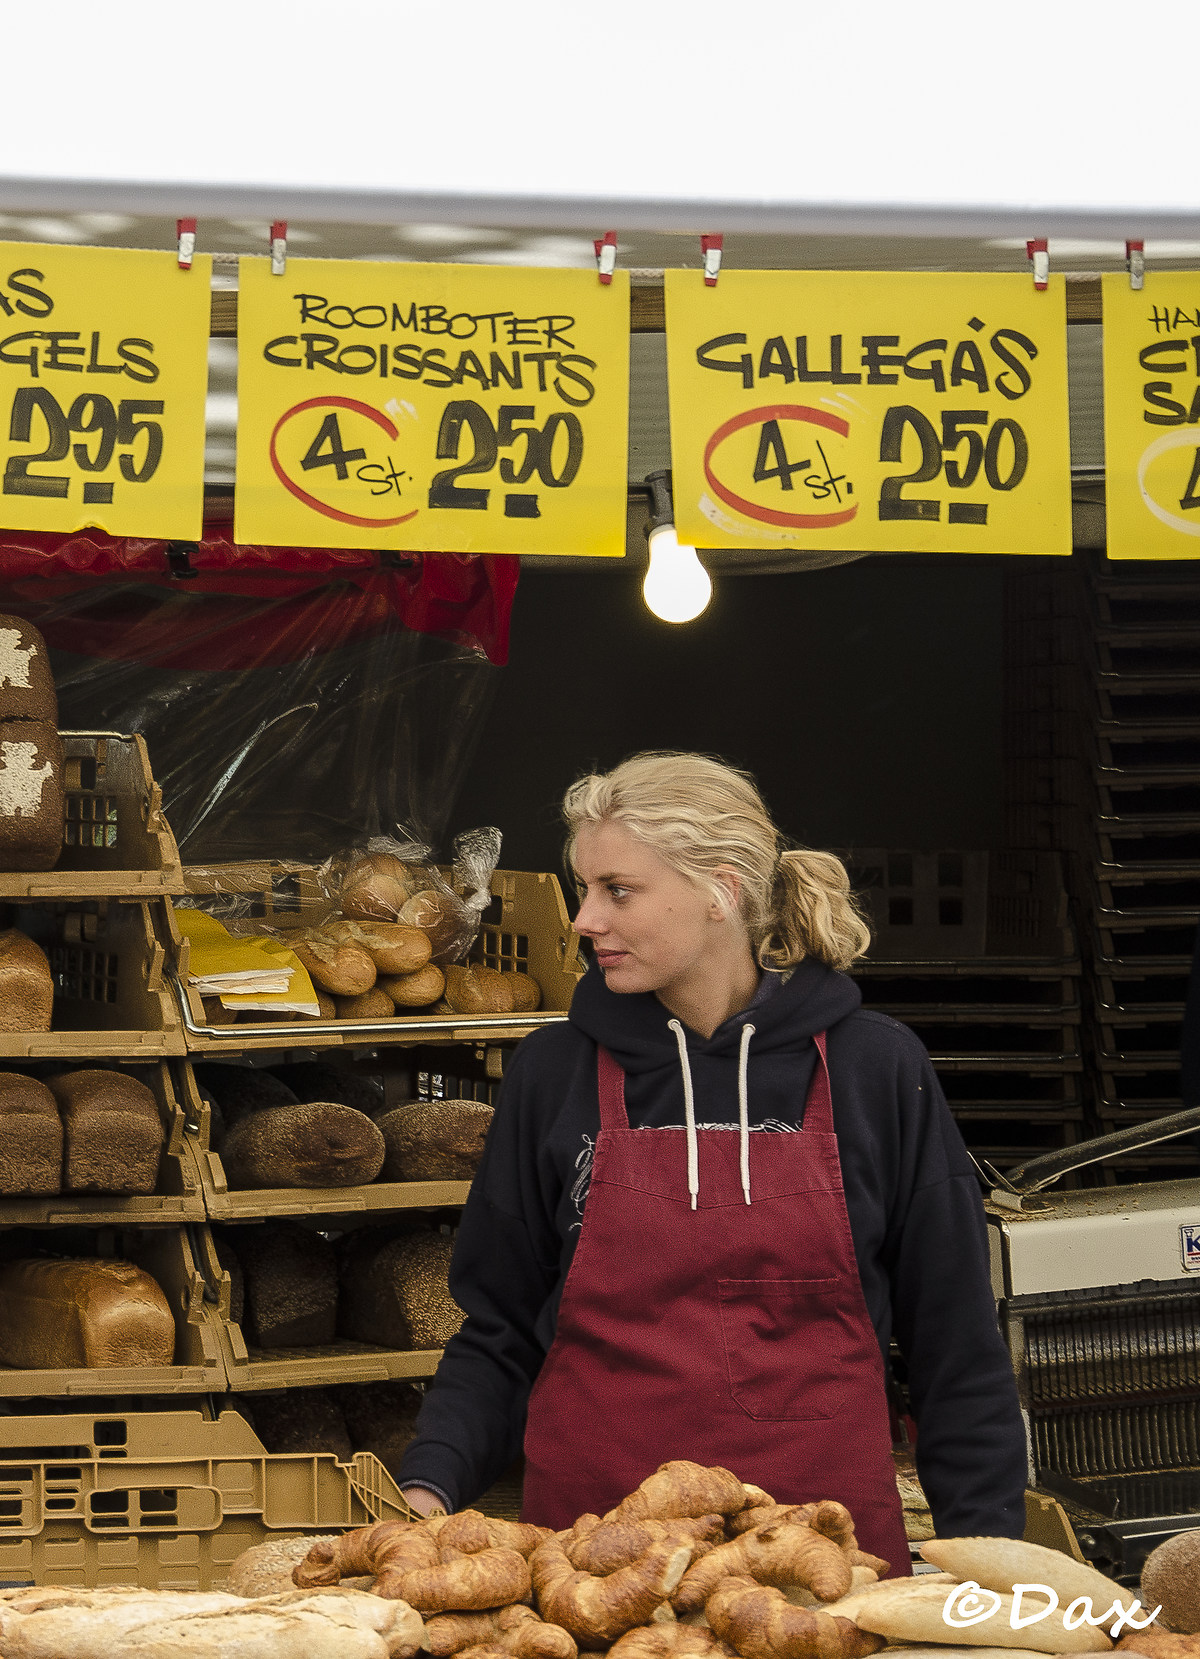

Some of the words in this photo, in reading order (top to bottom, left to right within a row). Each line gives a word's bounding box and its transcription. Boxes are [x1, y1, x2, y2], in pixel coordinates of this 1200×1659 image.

[292, 293, 577, 350] ROOMBOTER
[263, 332, 599, 408] CROISSANTS
[299, 412, 368, 481] 4
[752, 419, 812, 492] 4
